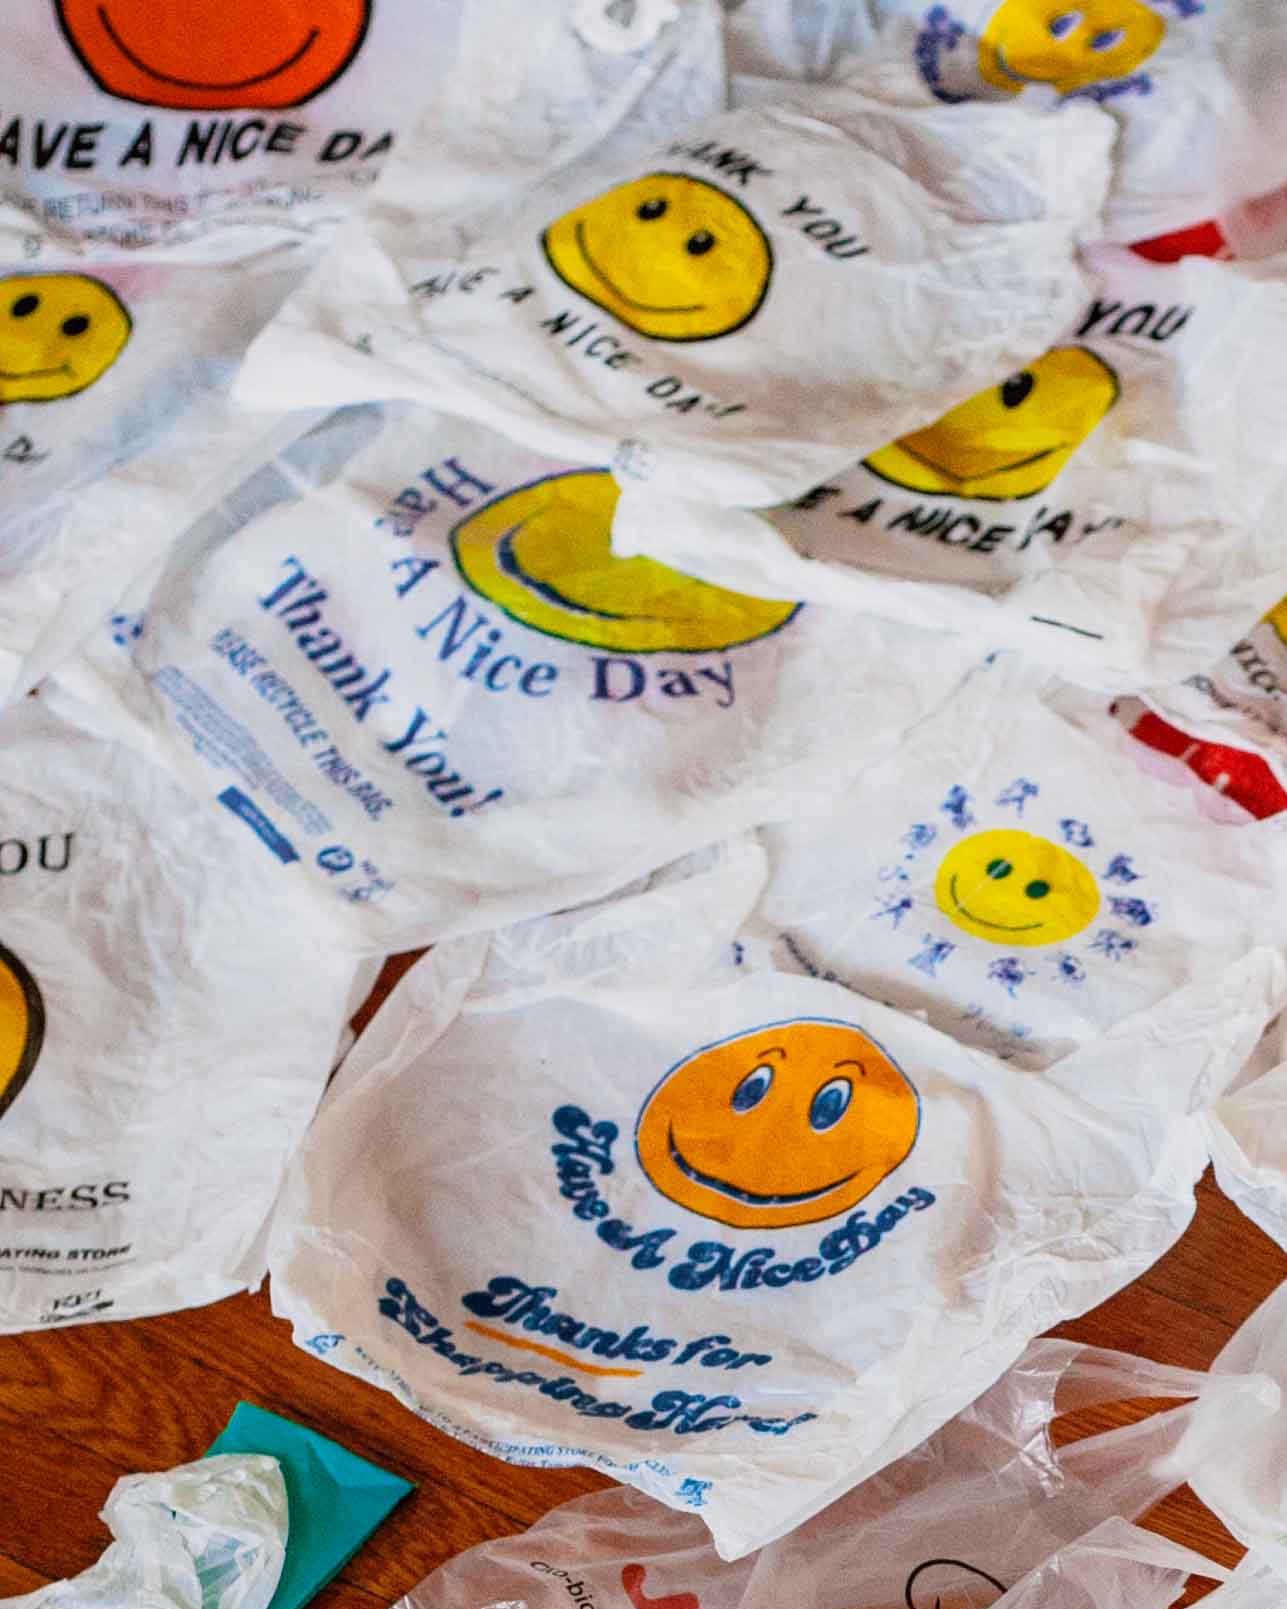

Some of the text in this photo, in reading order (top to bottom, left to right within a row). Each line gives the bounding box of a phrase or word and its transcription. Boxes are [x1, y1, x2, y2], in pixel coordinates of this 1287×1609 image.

[119, 121, 154, 168] A
[176, 119, 306, 166] NICE
[781, 196, 868, 260] YOU
[540, 311, 640, 371] NICE
[838, 500, 884, 525] A
[887, 505, 1017, 553] NICE
[392, 556, 736, 709] A Nice Day
[259, 555, 504, 818] Thank You!
[0, 1181, 131, 1212] NESS
[552, 1105, 619, 1221] Have
[668, 1240, 826, 1292] Nice
[818, 1186, 936, 1276] Day
[462, 1275, 773, 1372] Thanks for
